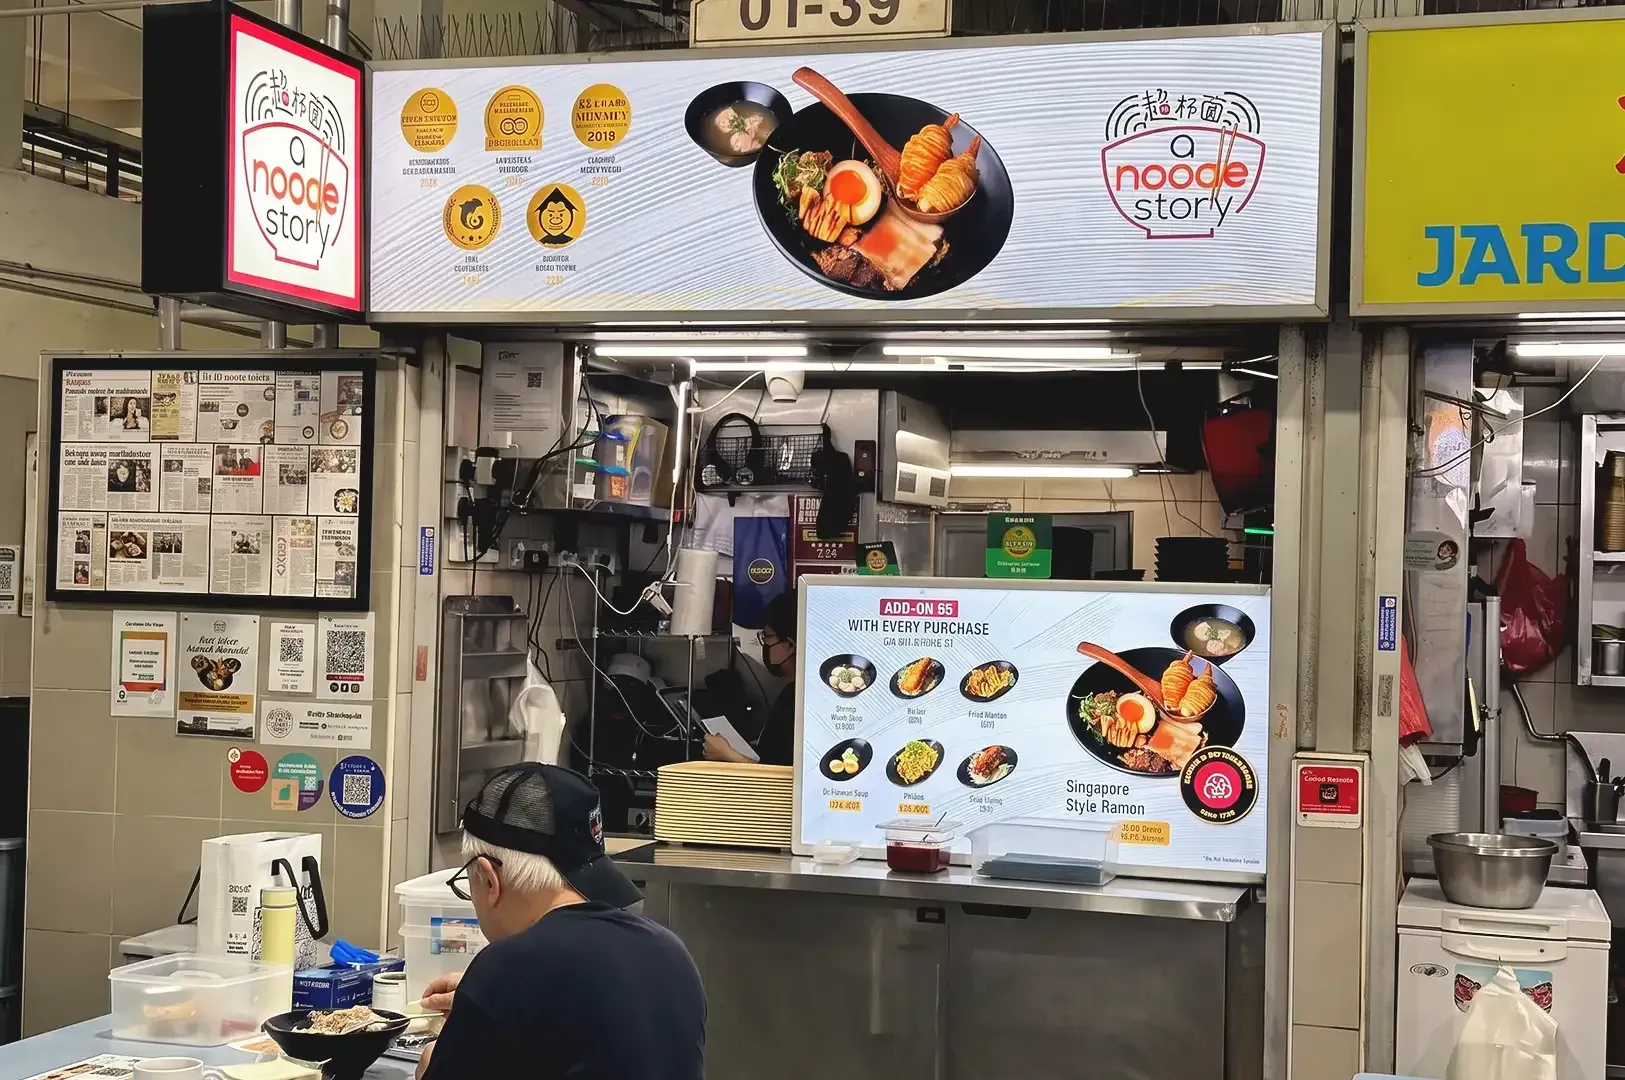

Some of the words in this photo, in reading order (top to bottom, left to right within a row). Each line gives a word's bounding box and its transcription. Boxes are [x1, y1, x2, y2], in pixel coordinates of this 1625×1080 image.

[289, 136, 306, 168] a
[1170, 134, 1195, 158] a
[1134, 193, 1233, 227] story
[266, 205, 330, 258] story
[884, 602, 933, 615] ADD-ON
[848, 619, 878, 632] WITH
[883, 620, 920, 633] EVERY
[924, 621, 989, 635] PURCHASE
[1066, 779, 1130, 798] Singapore
[1066, 798, 1097, 814] Style
[1101, 800, 1145, 815] Ramon
